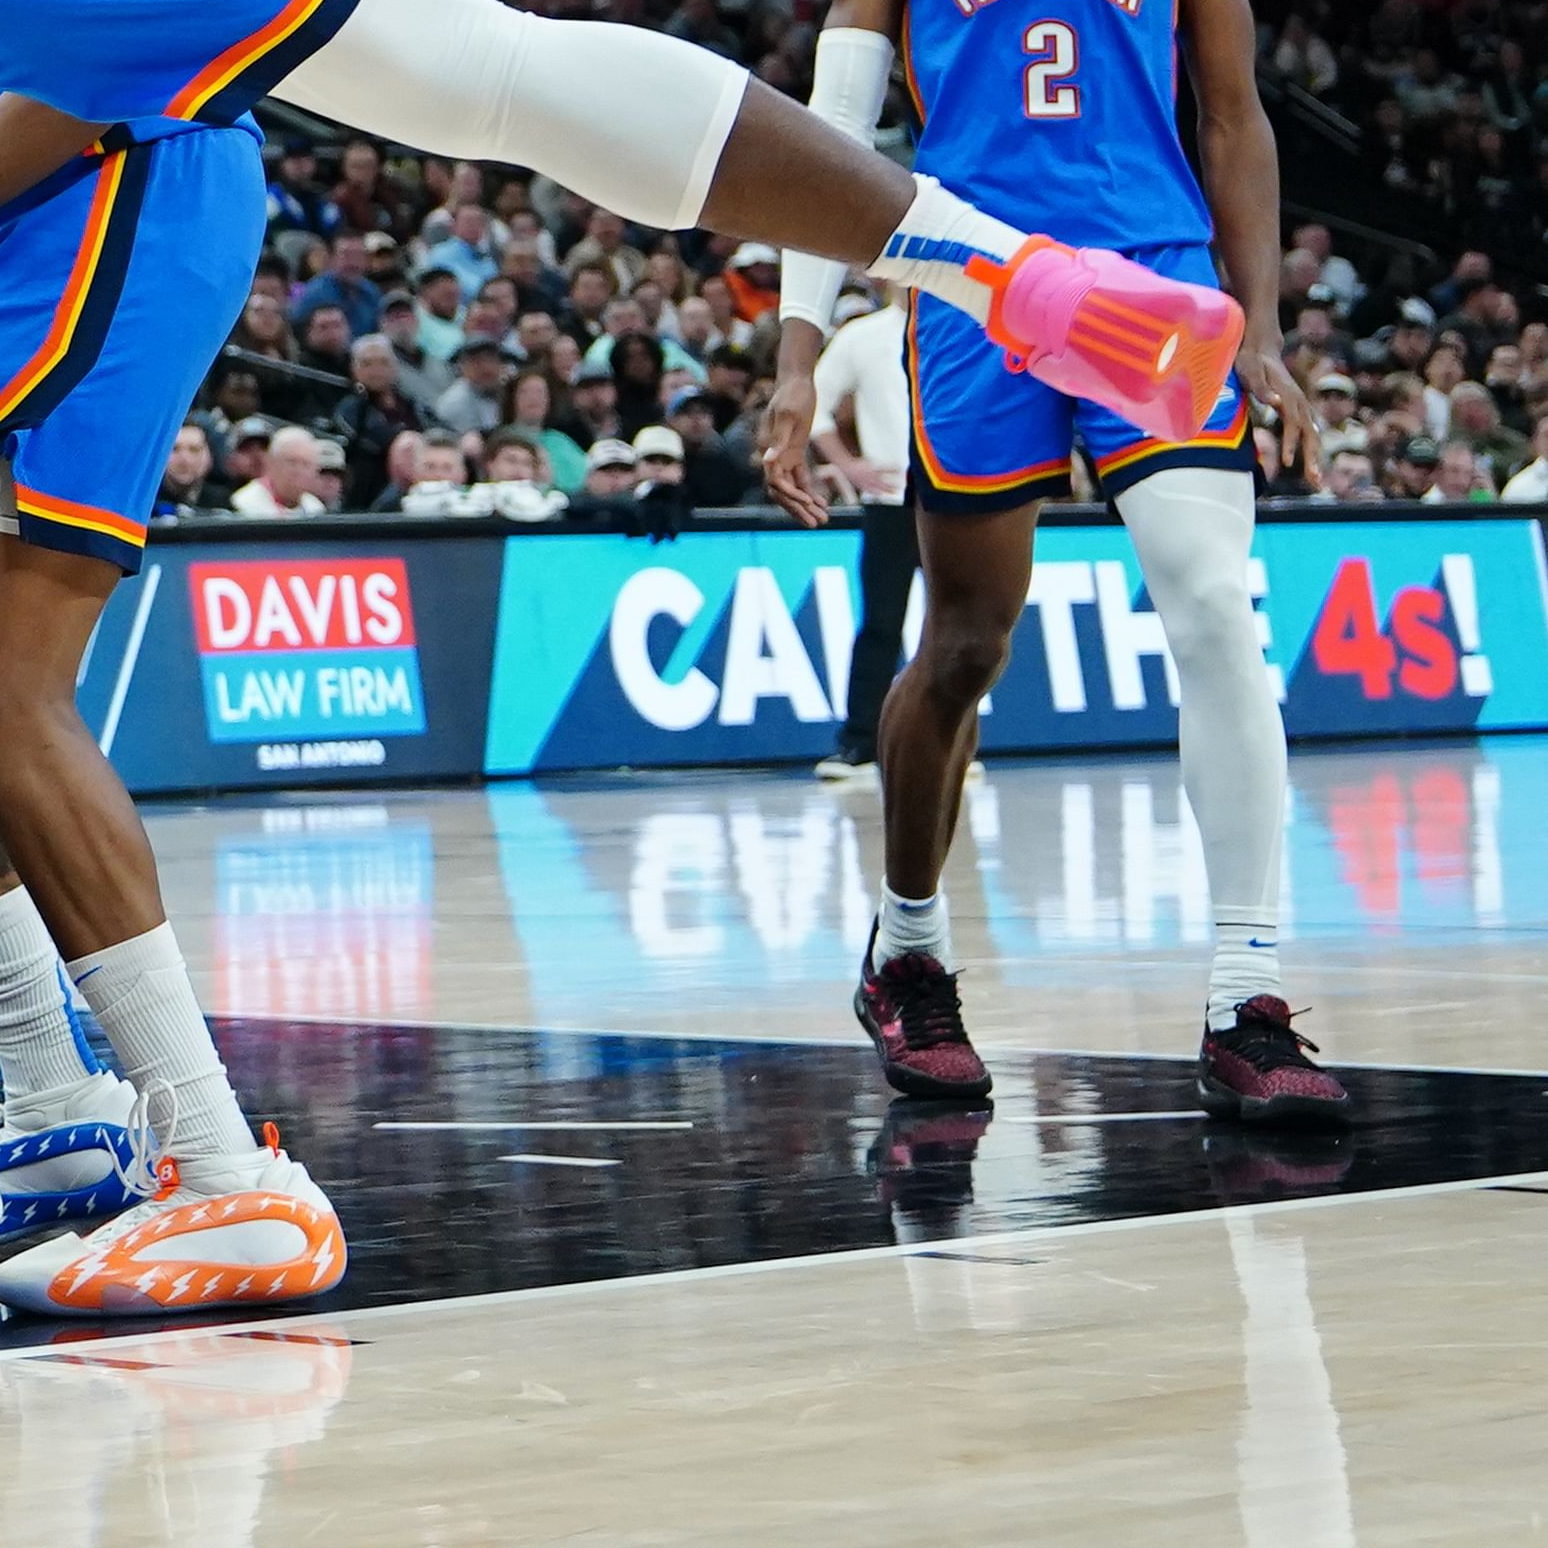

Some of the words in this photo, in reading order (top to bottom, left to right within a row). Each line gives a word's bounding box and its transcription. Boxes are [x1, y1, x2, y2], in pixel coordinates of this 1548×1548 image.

[1022, 18, 1081, 120] 2
[205, 572, 402, 648] DAVIS
[1313, 553, 1494, 699] 4s!
[216, 669, 304, 723] LAW
[316, 664, 412, 718] FIRM
